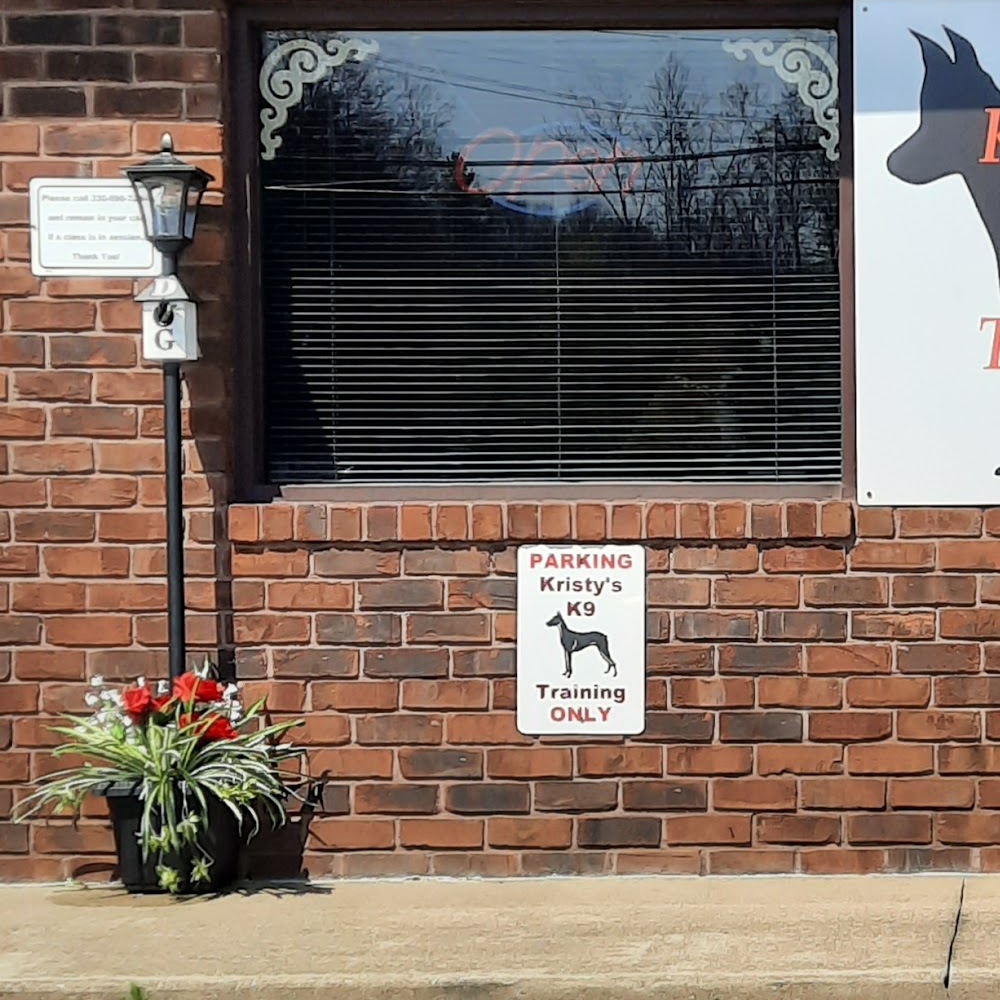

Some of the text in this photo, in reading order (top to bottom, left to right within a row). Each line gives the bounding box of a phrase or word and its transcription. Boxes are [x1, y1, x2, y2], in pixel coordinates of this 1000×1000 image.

[530, 553, 633, 569] PARKING
[540, 577, 622, 596] Kristy's
[567, 602, 595, 616] K9
[536, 684, 625, 703] Training
[550, 707, 612, 722] ONLY
